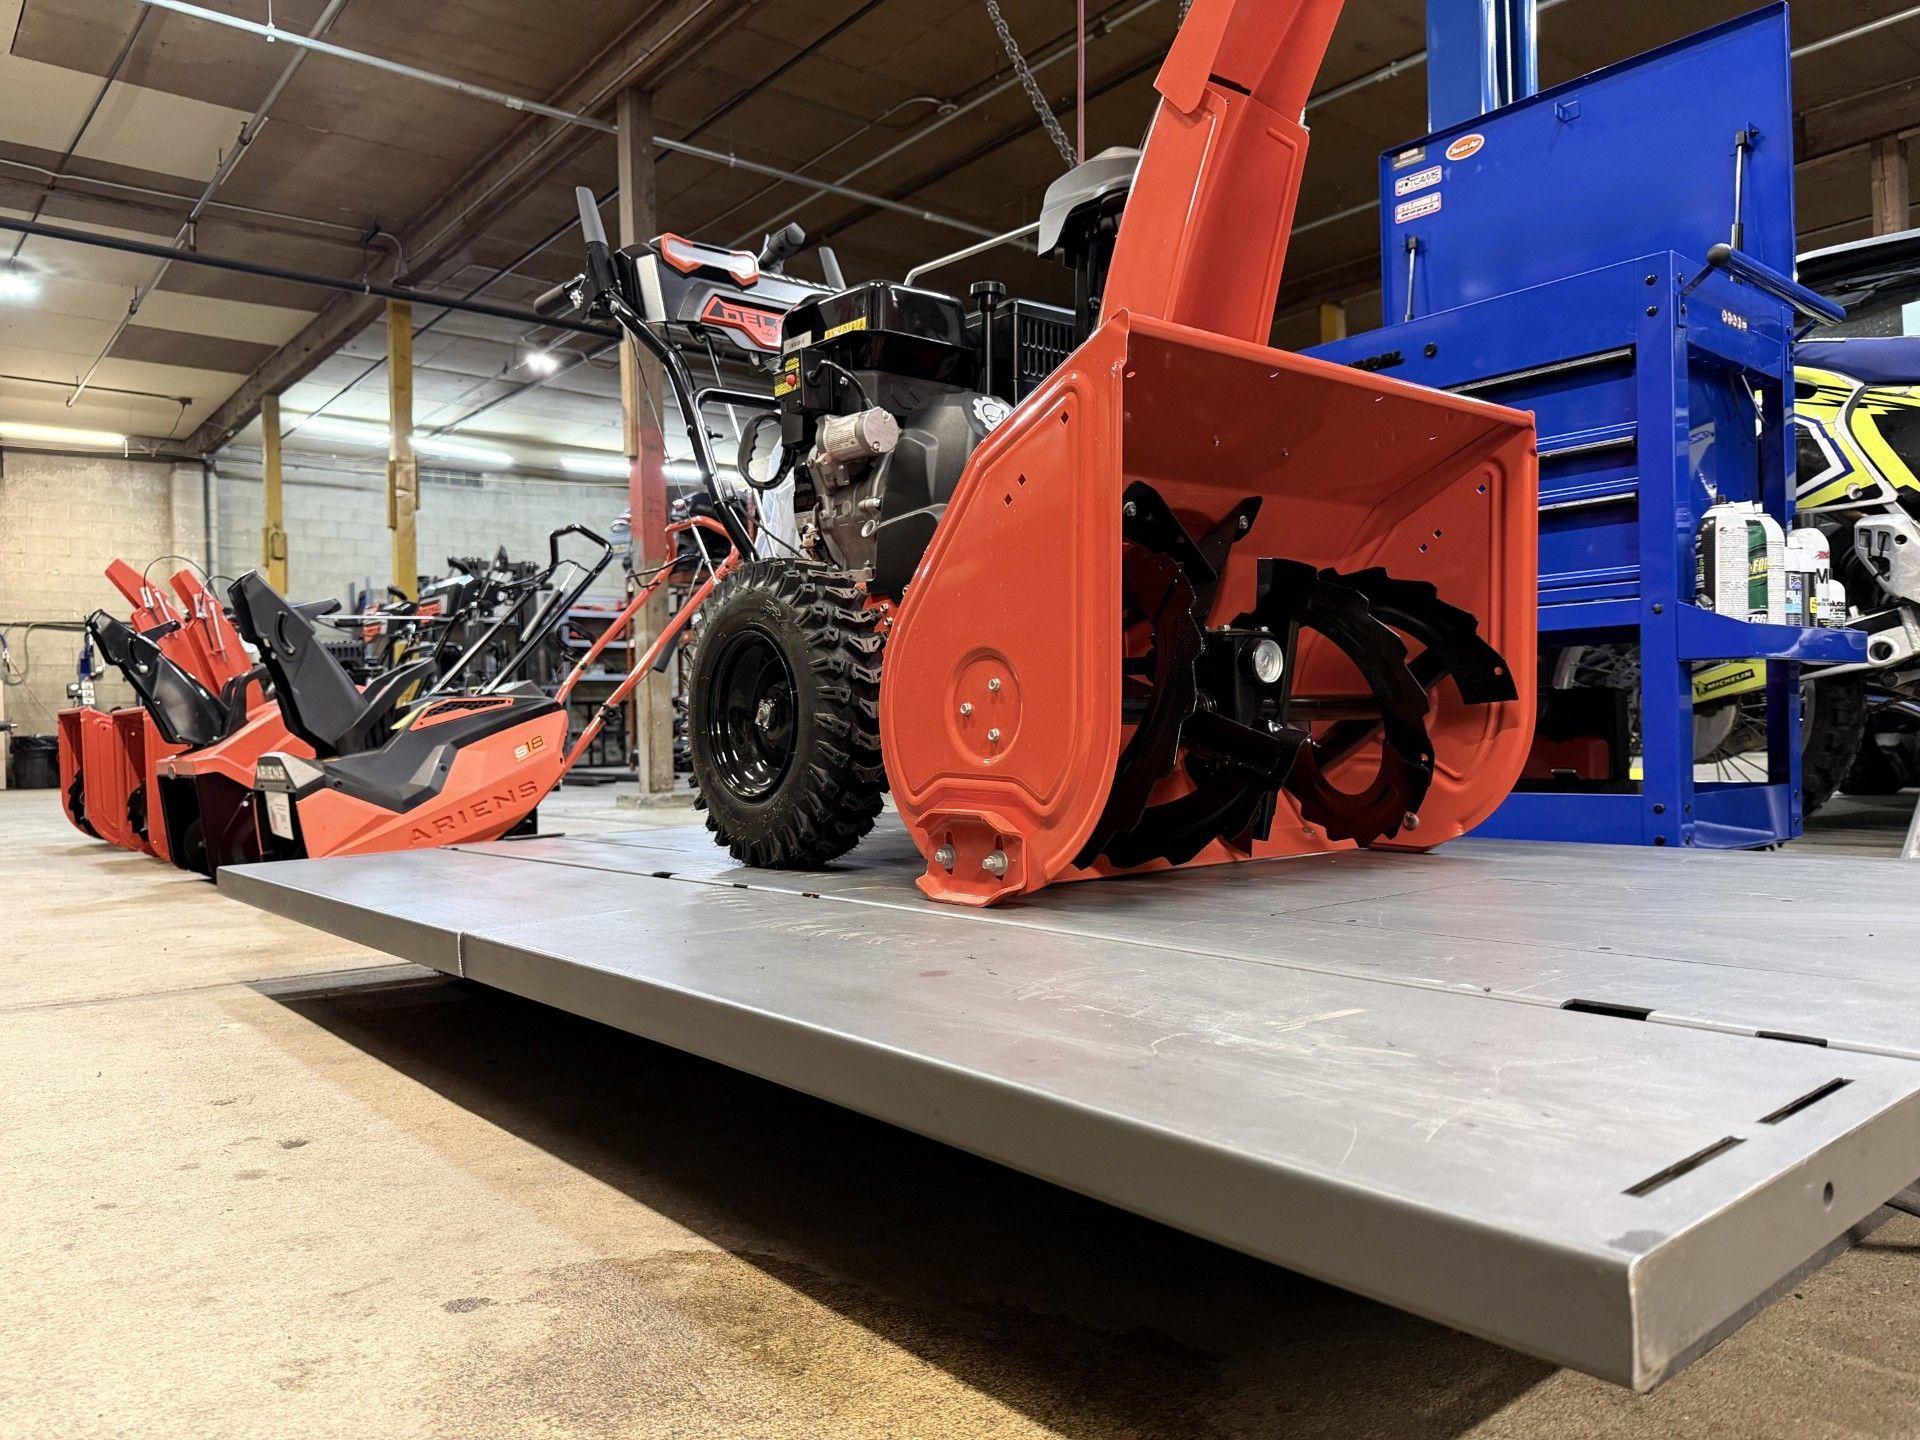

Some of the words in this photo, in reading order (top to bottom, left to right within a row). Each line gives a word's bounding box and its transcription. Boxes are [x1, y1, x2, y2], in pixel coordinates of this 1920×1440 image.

[1706, 671, 1752, 690] MICHELIN
[257, 765, 286, 780] ARIENS
[410, 780, 538, 845] ARIENS
